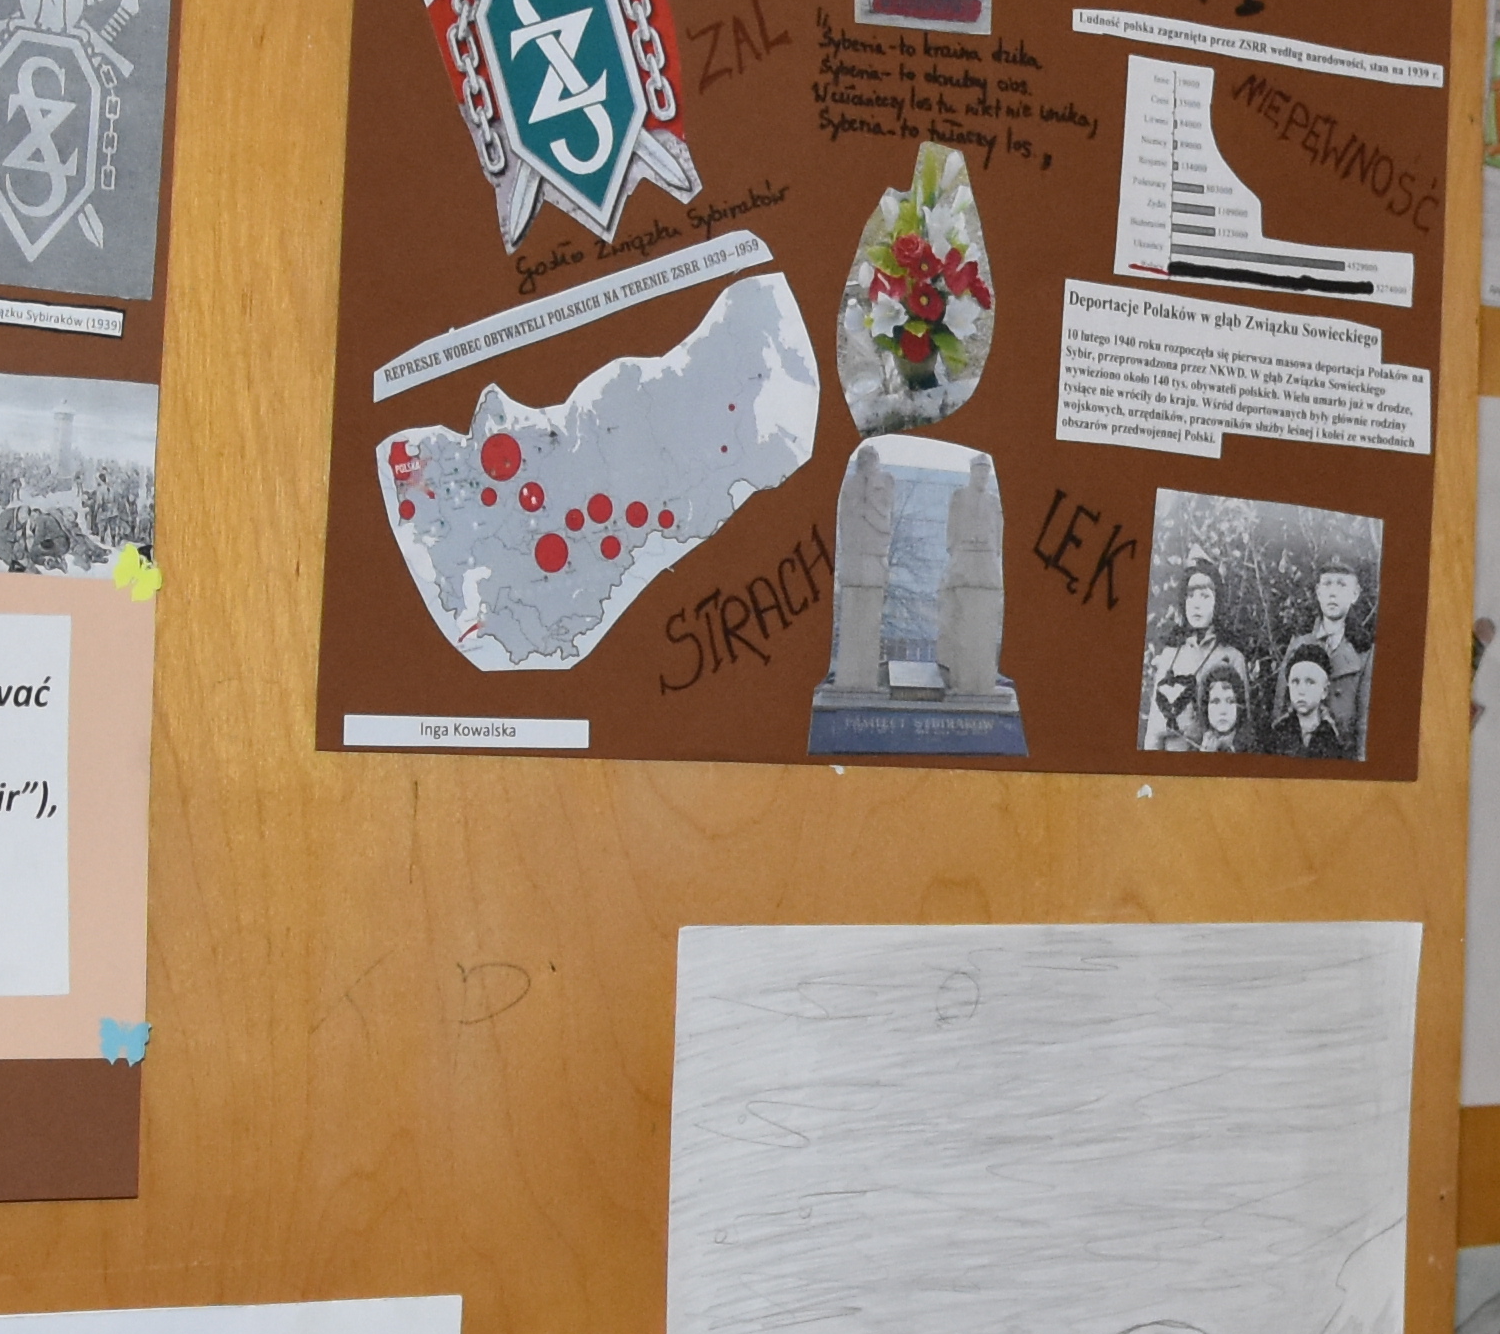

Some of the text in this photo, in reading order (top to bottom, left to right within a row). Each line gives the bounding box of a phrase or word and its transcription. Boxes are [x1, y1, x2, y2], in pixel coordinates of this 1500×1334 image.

[1079, 12, 1120, 29] Ludność
[1124, 21, 1153, 35] polska
[1157, 26, 1206, 45] zagarnięta
[1210, 35, 1235, 48] przez
[1239, 38, 1267, 54] ZSRR
[1270, 45, 1303, 62] według
[1306, 51, 1366, 71] narodowości,
[1369, 62, 1388, 74] stan
[1407, 65, 1429, 78] 1939
[595, 220, 680, 257] Związku
[687, 181, 789, 238] Sybiraków
[26, 309, 83, 328] Sybiraków
[86, 318, 122, 333] (1939)
[384, 353, 442, 383] REPRESJE
[443, 338, 482, 365] WOBEC
[484, 315, 546, 349] OBYWATELI
[547, 295, 600, 327] POLSKICH
[604, 291, 619, 306] NA
[620, 273, 669, 299] TERENIE
[671, 260, 700, 280] ZSRR
[1069, 290, 1379, 349] Deportacje Polaków w głąb Związku Sowieckiego
[1032, 489, 1136, 610] LĘK
[660, 524, 834, 695] STRACH
[420, 722, 516, 739] Inga Kowalska
